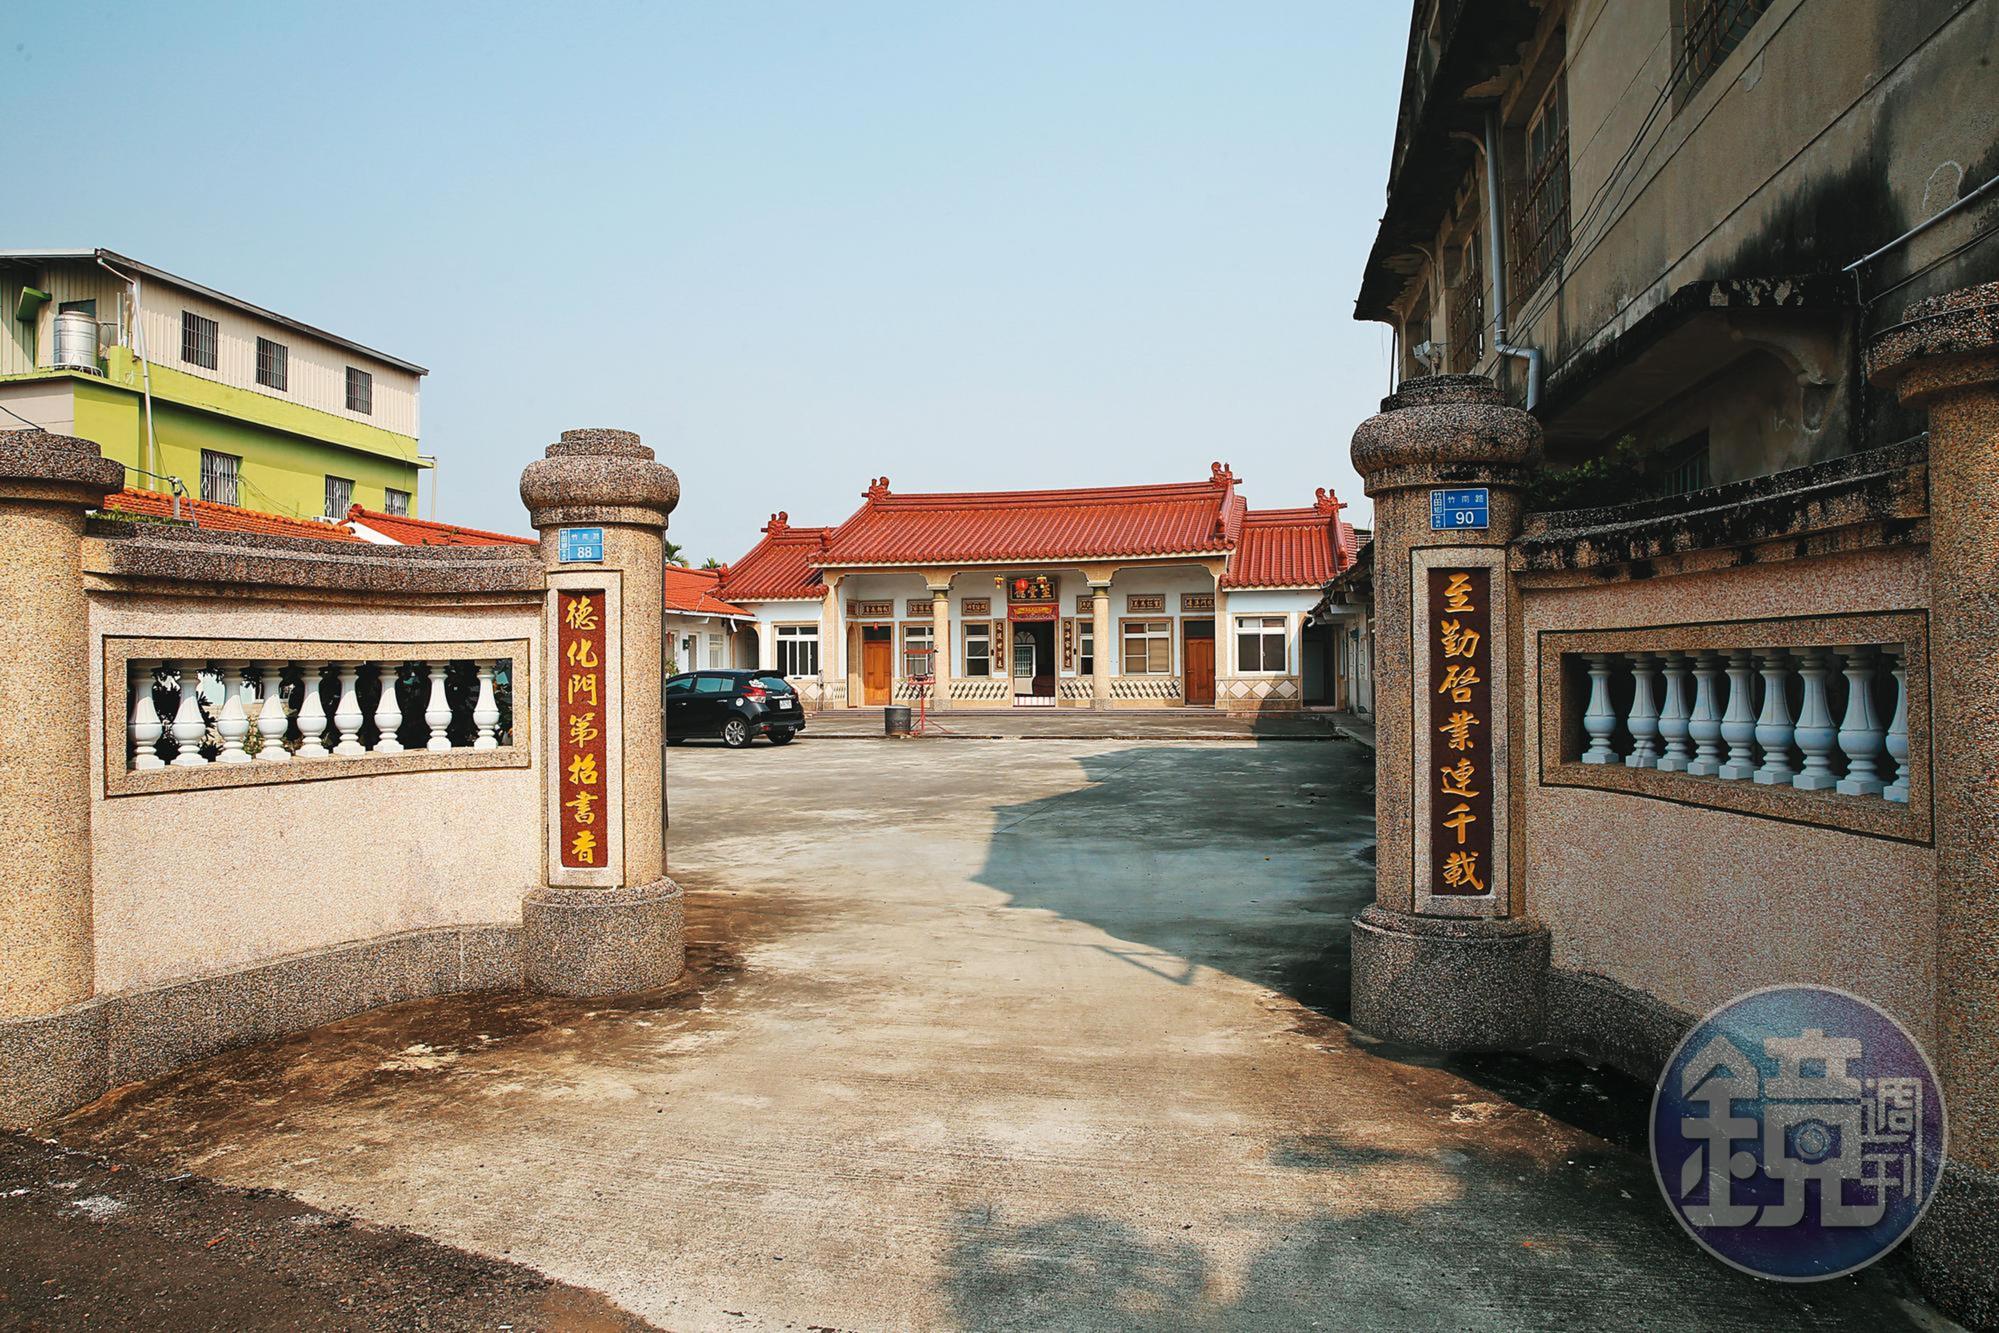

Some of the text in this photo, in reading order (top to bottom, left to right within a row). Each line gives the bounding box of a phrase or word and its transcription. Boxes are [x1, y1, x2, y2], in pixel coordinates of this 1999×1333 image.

[1433, 492, 1443, 514] 竹田鄉
[1447, 494, 1485, 504] 竹南路
[1455, 511, 1475, 525] 90
[577, 546, 593, 559] 88
[564, 595, 600, 865] 德化門第招書香
